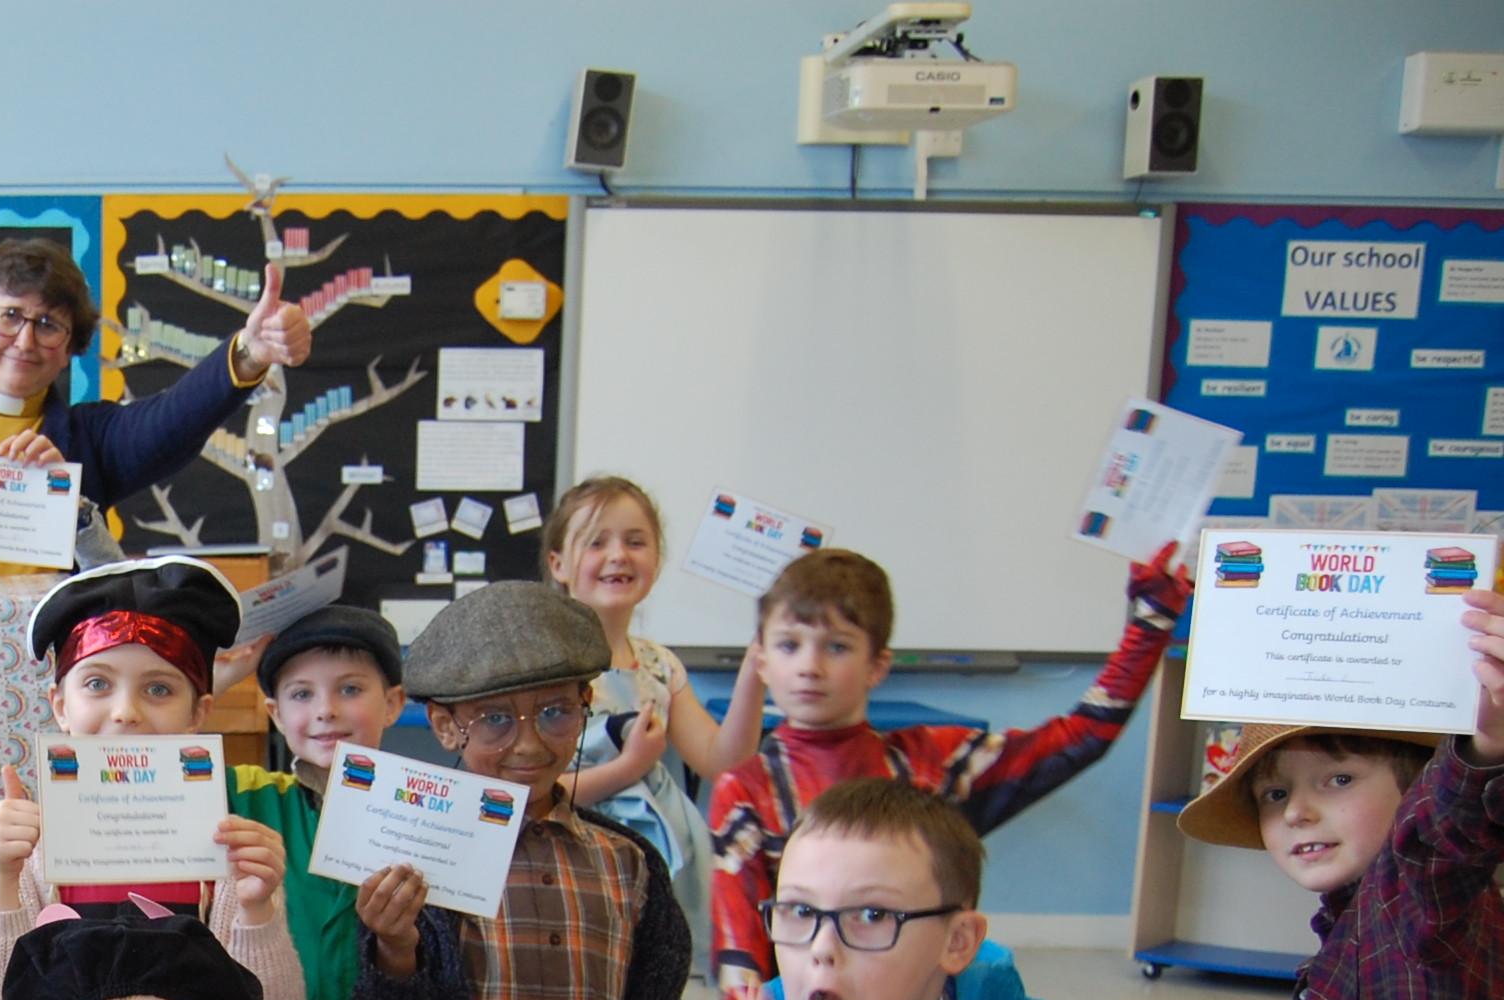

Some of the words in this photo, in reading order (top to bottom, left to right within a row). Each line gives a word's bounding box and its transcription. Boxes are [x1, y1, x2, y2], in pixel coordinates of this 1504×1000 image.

[915, 71, 961, 81] CASIO
[1290, 245, 1336, 266] Our
[1343, 247, 1421, 269] school
[1304, 290, 1397, 312] VALUES
[1415, 355, 1426, 363] be
[1205, 384, 1216, 393] be
[1349, 413, 1361, 422] be
[1270, 437, 1281, 447] be
[10, 480, 28, 494] DAY
[1311, 553, 1375, 573] WORLD
[1296, 573, 1341, 592] BOOK
[1348, 575, 1385, 594] DAY
[1256, 605, 1320, 620] Certificate
[1323, 607, 1337, 621] of
[1340, 608, 1423, 621] Achievement
[1281, 629, 1389, 645] Congratulations!
[1265, 652, 1284, 661] This
[1287, 653, 1332, 665] certificate
[1335, 655, 1344, 663] is
[1346, 656, 1389, 665] awarded
[1392, 657, 1403, 666] to
[1202, 687, 1217, 698] for
[1229, 688, 1259, 700] highly
[1263, 690, 1322, 702] imaginative
[1324, 693, 1354, 703] World
[1358, 695, 1383, 704] Book
[1385, 696, 1405, 708] Day
[107, 754, 148, 768] WORLD
[100, 770, 130, 784] BOOK
[134, 770, 157, 784] DAY
[406, 776, 449, 798] WORLD
[394, 788, 424, 807] BOOK
[428, 796, 454, 814] DAY
